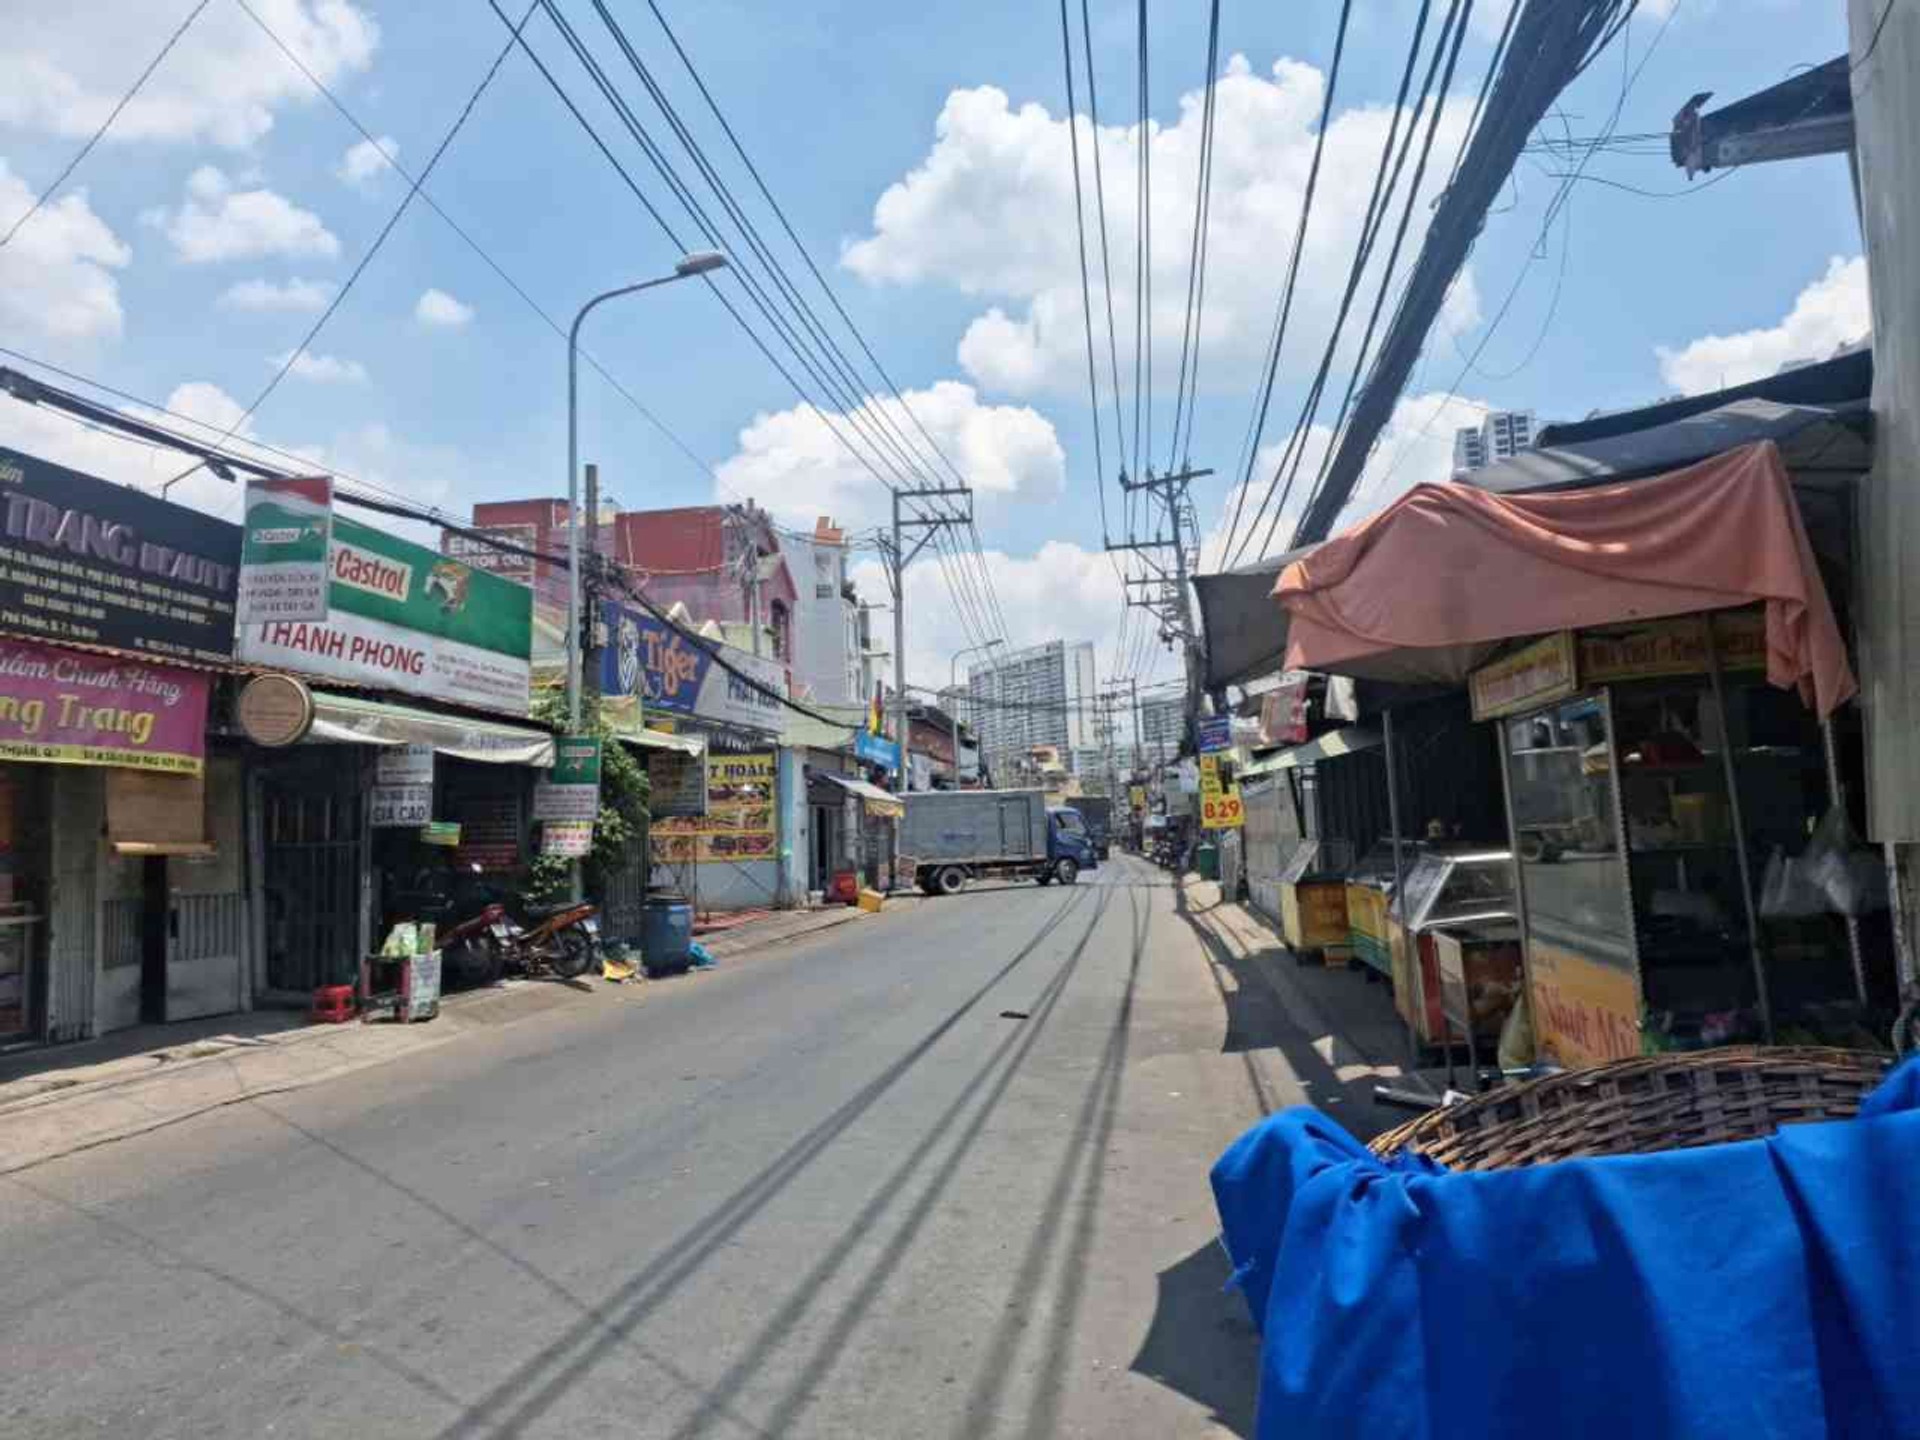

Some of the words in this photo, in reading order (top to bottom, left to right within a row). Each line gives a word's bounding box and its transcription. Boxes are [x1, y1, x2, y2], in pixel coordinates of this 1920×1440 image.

[335, 549, 407, 597] Castrol
[260, 621, 347, 660] THANH
[349, 635, 426, 675] PHONG
[641, 629, 698, 696] Tiger
[57, 693, 154, 745] Trang
